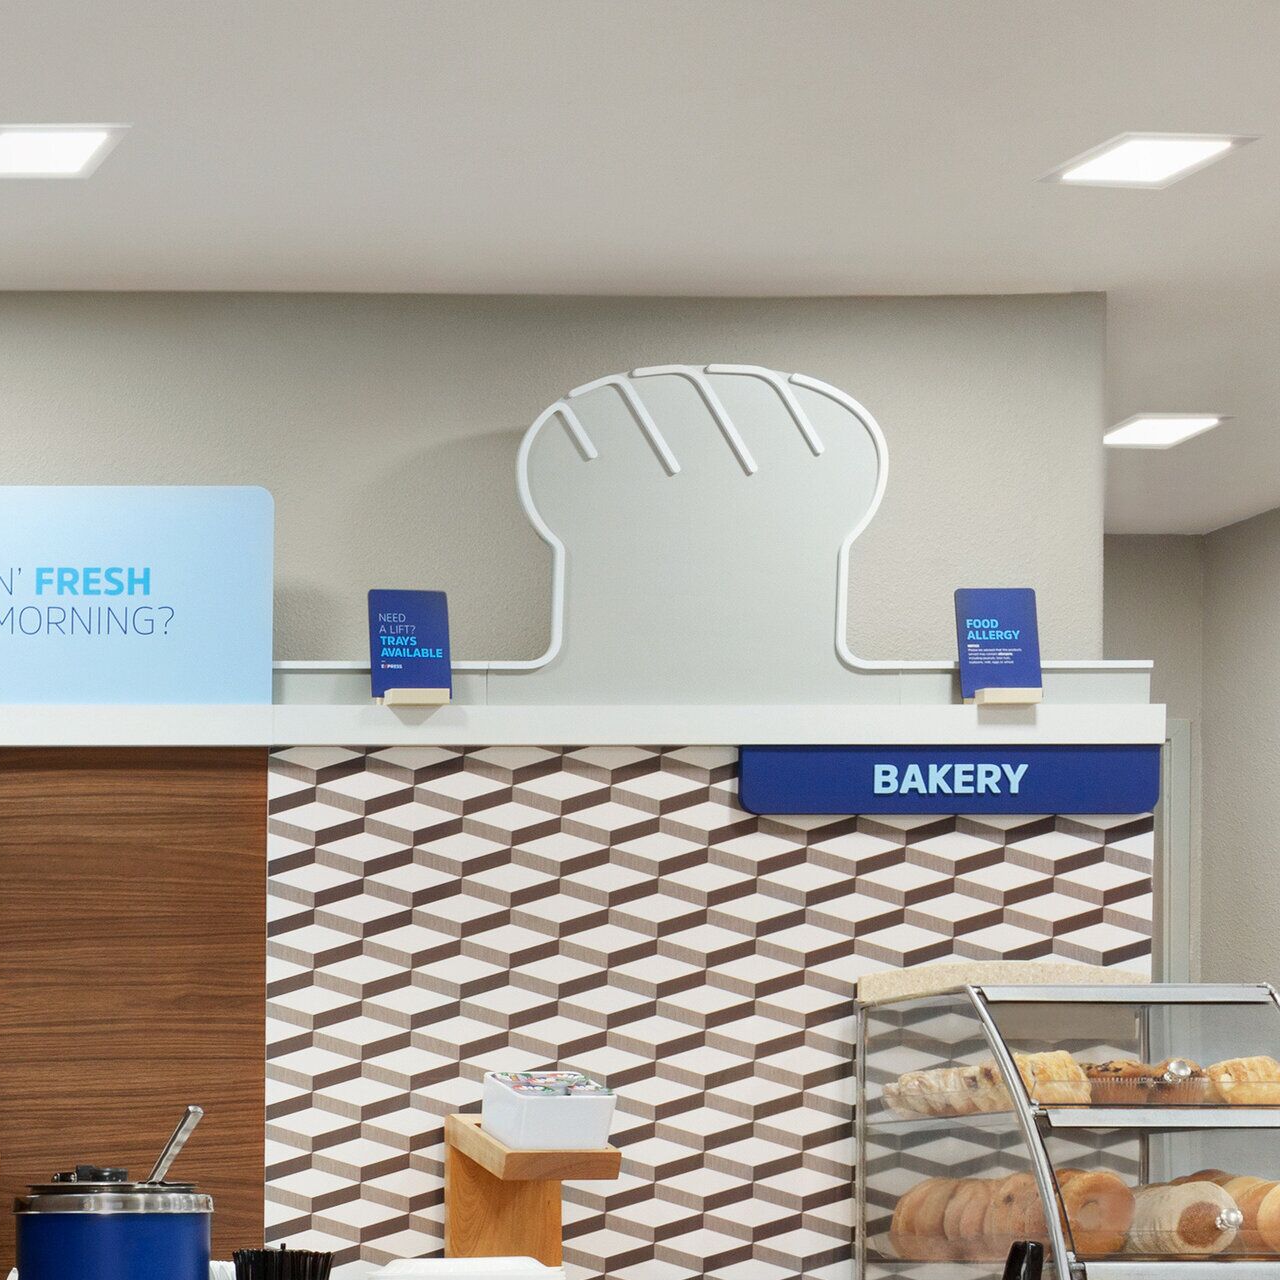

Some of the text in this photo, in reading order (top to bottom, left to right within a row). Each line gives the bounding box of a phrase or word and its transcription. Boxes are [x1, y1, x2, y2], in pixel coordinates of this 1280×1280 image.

[35, 567, 151, 596] FRESH
[378, 613, 406, 622] NEED
[966, 619, 999, 628] FOOD
[379, 625, 416, 634] A LIFT?
[967, 630, 1020, 640] ALLERGY
[380, 636, 417, 646] TRAYS
[381, 648, 443, 658] AVAILABLE
[873, 763, 1029, 794] BAKERY
